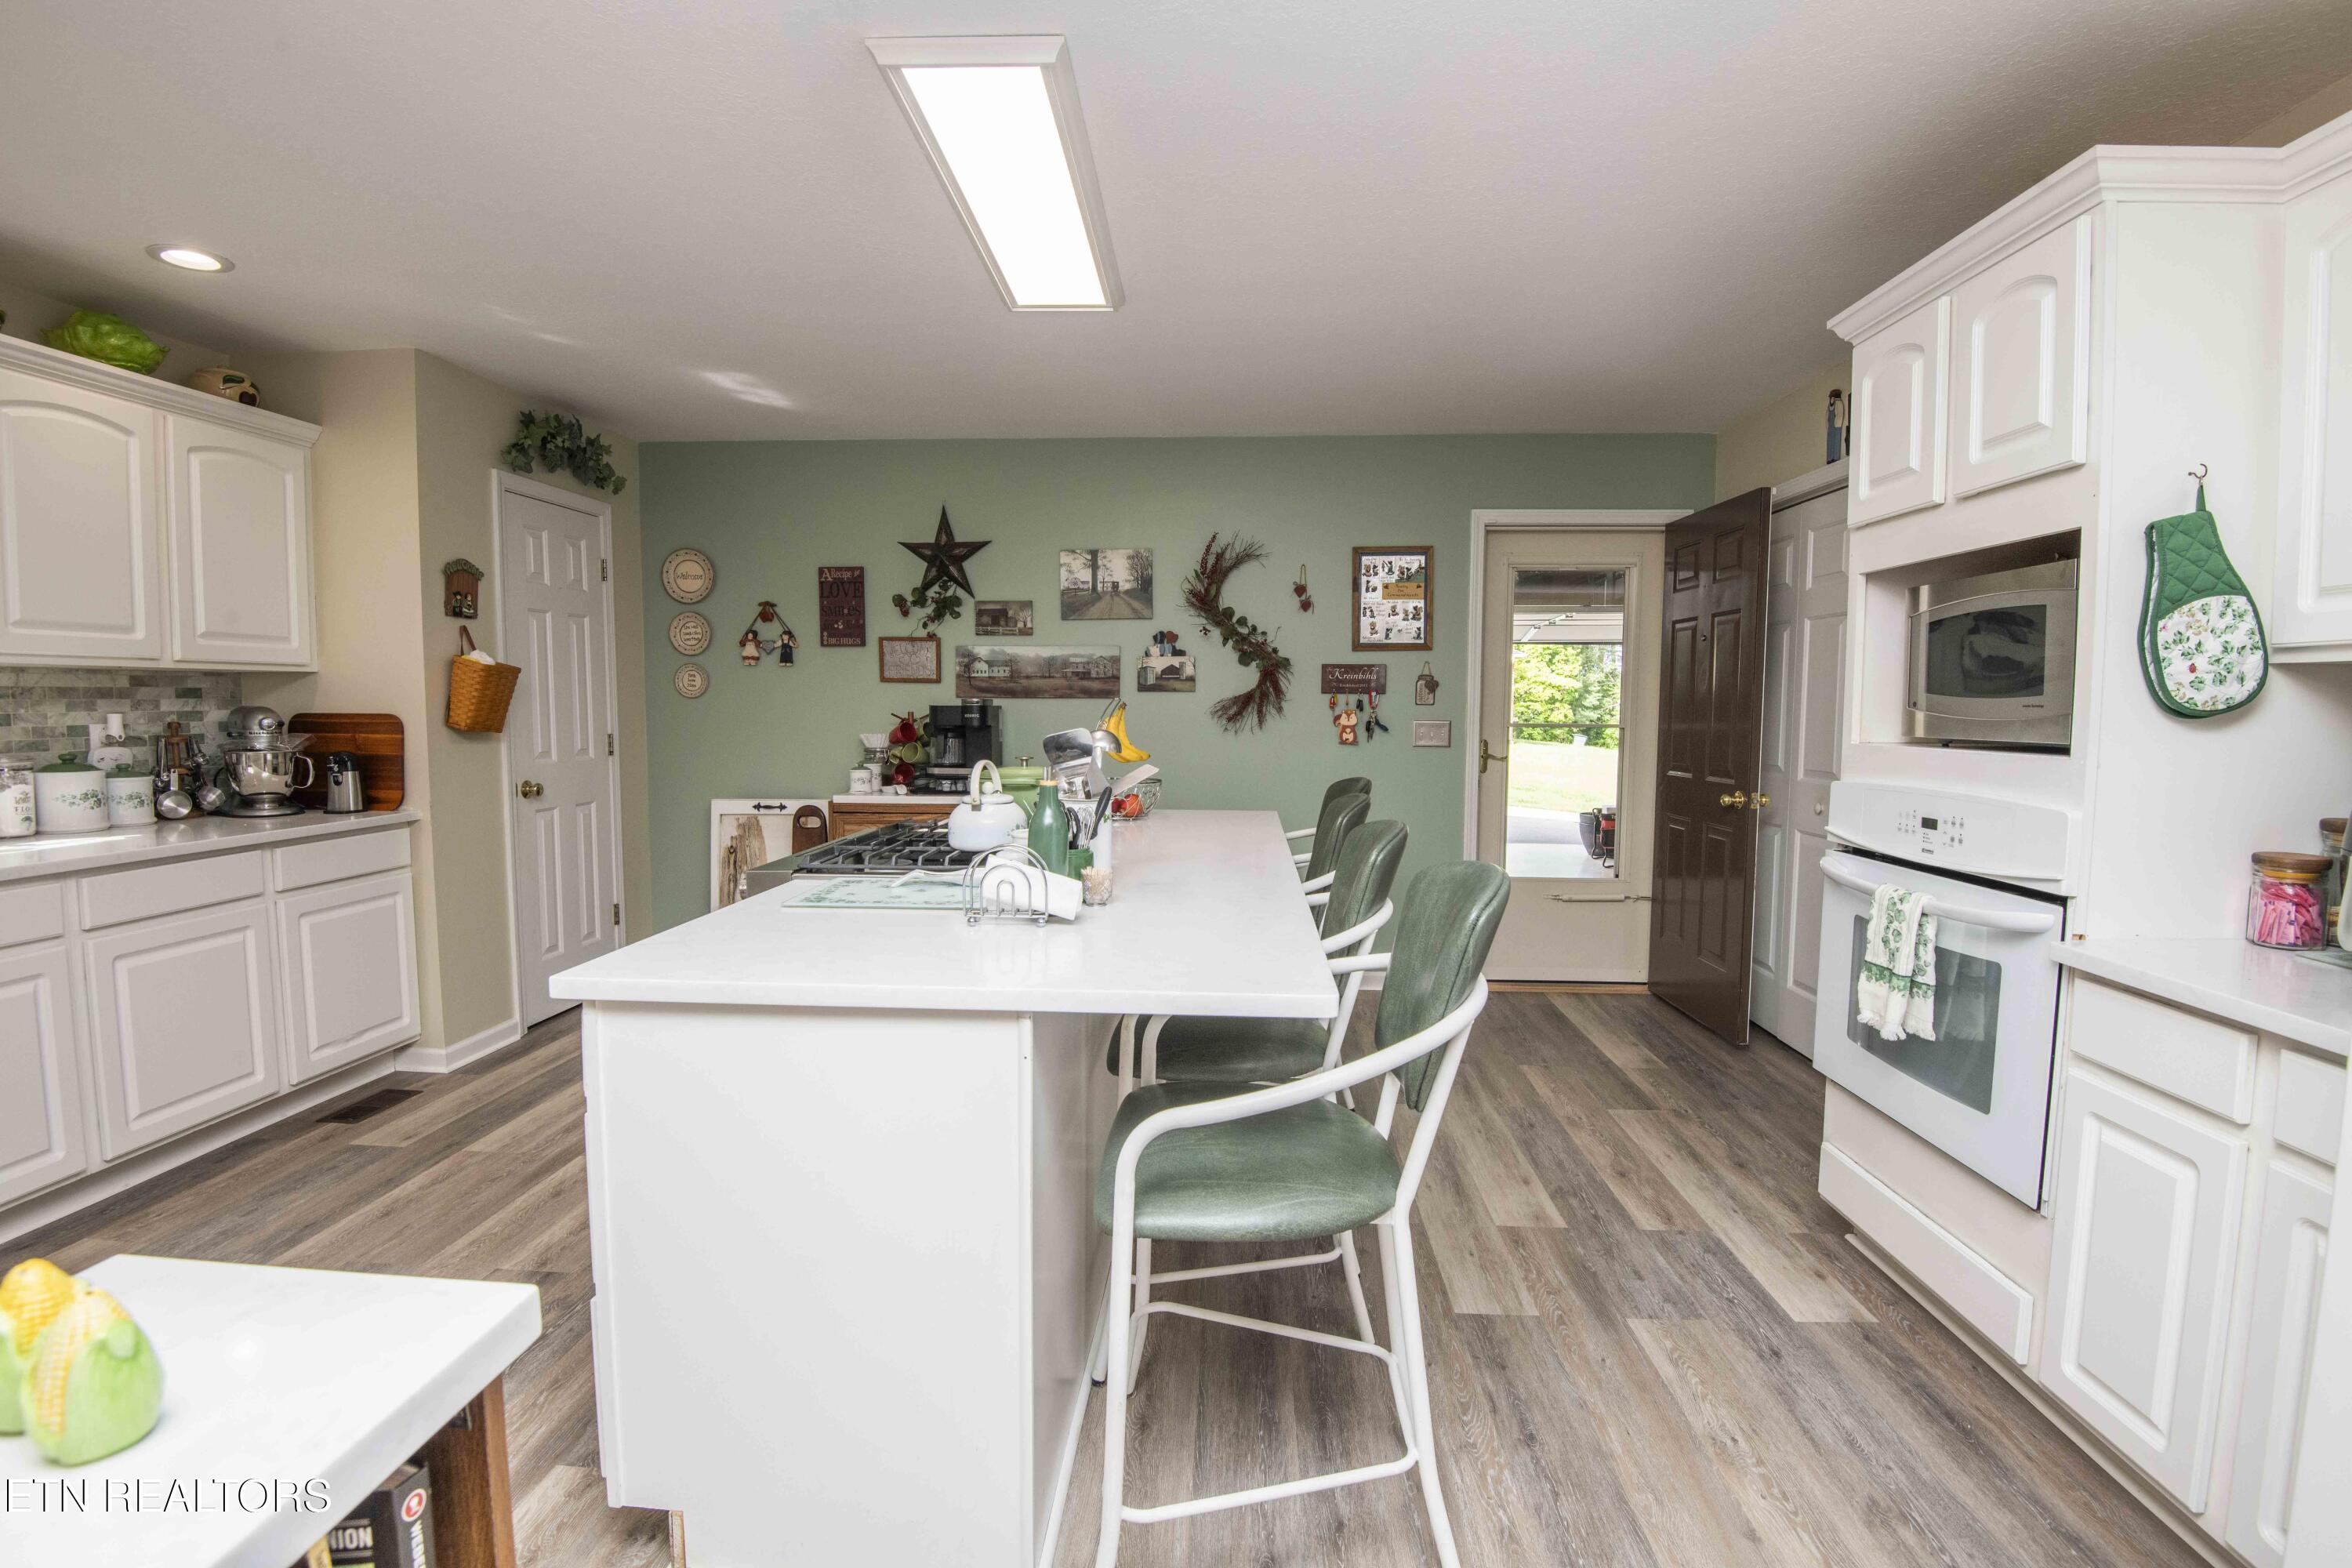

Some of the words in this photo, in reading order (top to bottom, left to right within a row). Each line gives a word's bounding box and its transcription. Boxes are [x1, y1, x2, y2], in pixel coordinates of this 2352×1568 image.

[676, 571, 703, 580] Welcome
[821, 568, 833, 581] A
[831, 568, 852, 580] Recipe
[819, 581, 863, 599] LOVE
[1329, 667, 1379, 680] Kreinbihls
